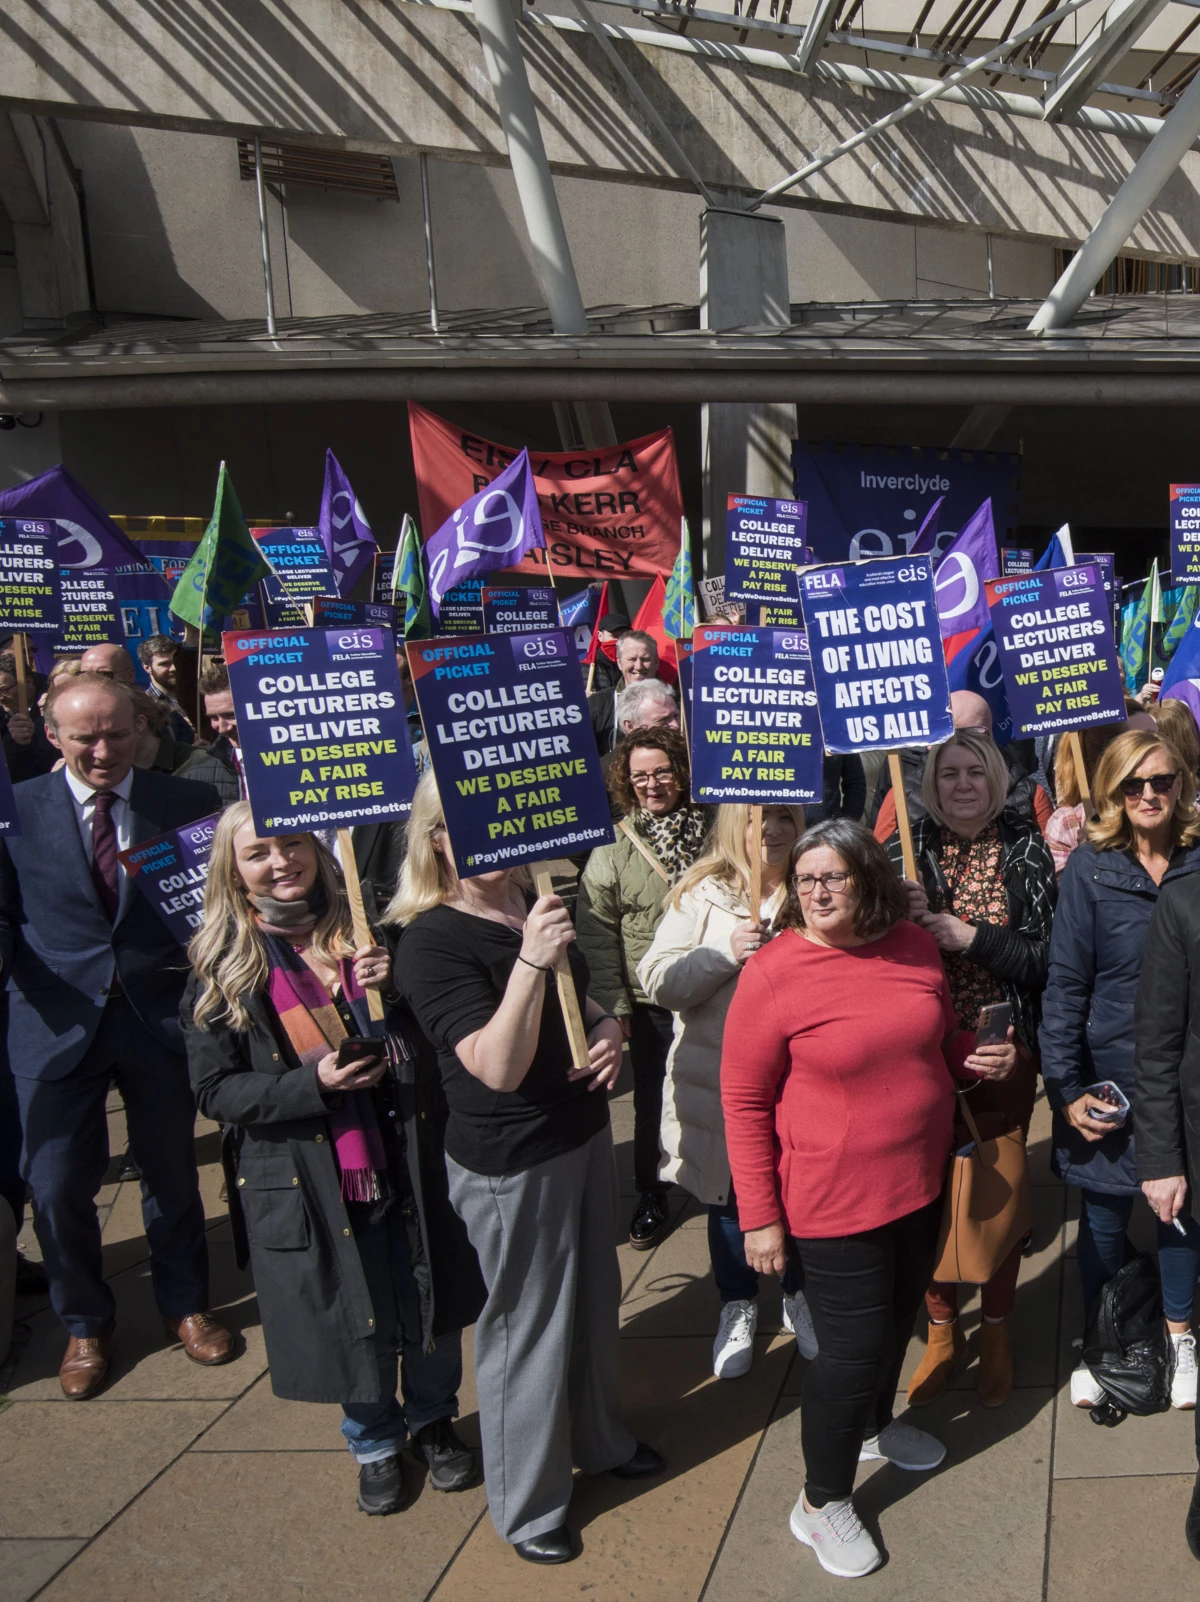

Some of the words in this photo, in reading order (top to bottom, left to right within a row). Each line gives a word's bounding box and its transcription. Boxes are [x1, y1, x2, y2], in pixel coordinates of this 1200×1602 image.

[564, 451, 638, 478] CLA
[861, 471, 949, 494] Inverclyde
[552, 491, 641, 516] KERR
[734, 497, 768, 507] OFFICIAL
[781, 503, 798, 514] eis
[737, 506, 764, 515] PICKET
[23, 522, 44, 533] eis
[566, 522, 644, 538] BRANCH
[740, 519, 795, 534] COLLEGE
[732, 531, 801, 548] LECTURERS
[522, 543, 636, 570] AISLEY
[740, 546, 792, 560] DELIVER
[756, 559, 798, 572] DESERVE
[898, 564, 927, 583] eis
[764, 582, 787, 592] RISE
[805, 573, 841, 589] FELA
[994, 578, 1043, 594] OFFICIAL
[1063, 569, 1088, 588] eis
[6, 597, 33, 606] FAIR
[729, 592, 798, 603] #PayWeDeserveBetter
[1002, 592, 1040, 606] PICKET
[14, 609, 43, 617] RISE
[815, 610, 859, 637] THE
[864, 600, 926, 632] COST
[1010, 602, 1091, 629] COLLEGE
[237, 636, 309, 650] OFFICIAL
[338, 632, 373, 649] eis
[704, 631, 759, 643] OFFICIAL
[782, 631, 809, 650] eis
[1003, 620, 1106, 650] LECTURERS
[248, 652, 303, 666] PICKET
[422, 644, 494, 661] OFFICIAL
[524, 637, 557, 657] eis
[710, 646, 753, 657] PICKET
[822, 648, 850, 674] OF
[856, 637, 933, 671] LIVING
[1020, 642, 1096, 668] DELIVER
[434, 662, 490, 680] PICKET
[519, 663, 536, 672] FELA
[714, 666, 806, 685] COLLEGE
[1042, 660, 1108, 681] DESERVE
[259, 670, 376, 694] COLLEGE
[835, 674, 932, 709] AFFECTS
[1055, 680, 1088, 694] FAIR
[245, 692, 395, 720] LECTURERS
[448, 680, 563, 713] COLLEGE
[702, 687, 817, 706] LECTURERS
[1067, 694, 1100, 710] RISE
[436, 705, 582, 744] LECTURERS
[716, 710, 802, 727] DELIVER
[846, 716, 879, 742] US
[884, 711, 930, 739] ALL!
[1021, 708, 1120, 732] #PayWeDeserveBetter
[270, 718, 381, 744] DELIVER
[736, 731, 811, 746] DESERVE
[260, 750, 296, 766] WE
[301, 740, 397, 762] DESERVE
[463, 735, 571, 770] DELIVER
[320, 763, 367, 781] FAIR
[456, 776, 492, 796] WE
[496, 759, 587, 789] DESERVE
[757, 768, 795, 781] RISE
[289, 788, 329, 806] PAY
[335, 782, 384, 800] RISE
[515, 787, 561, 810] FAIR
[699, 787, 815, 798] #PayWeDeserveBetter
[265, 802, 412, 828] #PayWeDeserveBetter
[488, 818, 529, 840] PAY
[532, 807, 578, 830] RISE
[129, 841, 174, 863] OFFICIAL
[466, 828, 605, 867] #PayWeDeserveBetter
[142, 854, 177, 874] PICKET
[159, 863, 210, 893] COLLE
